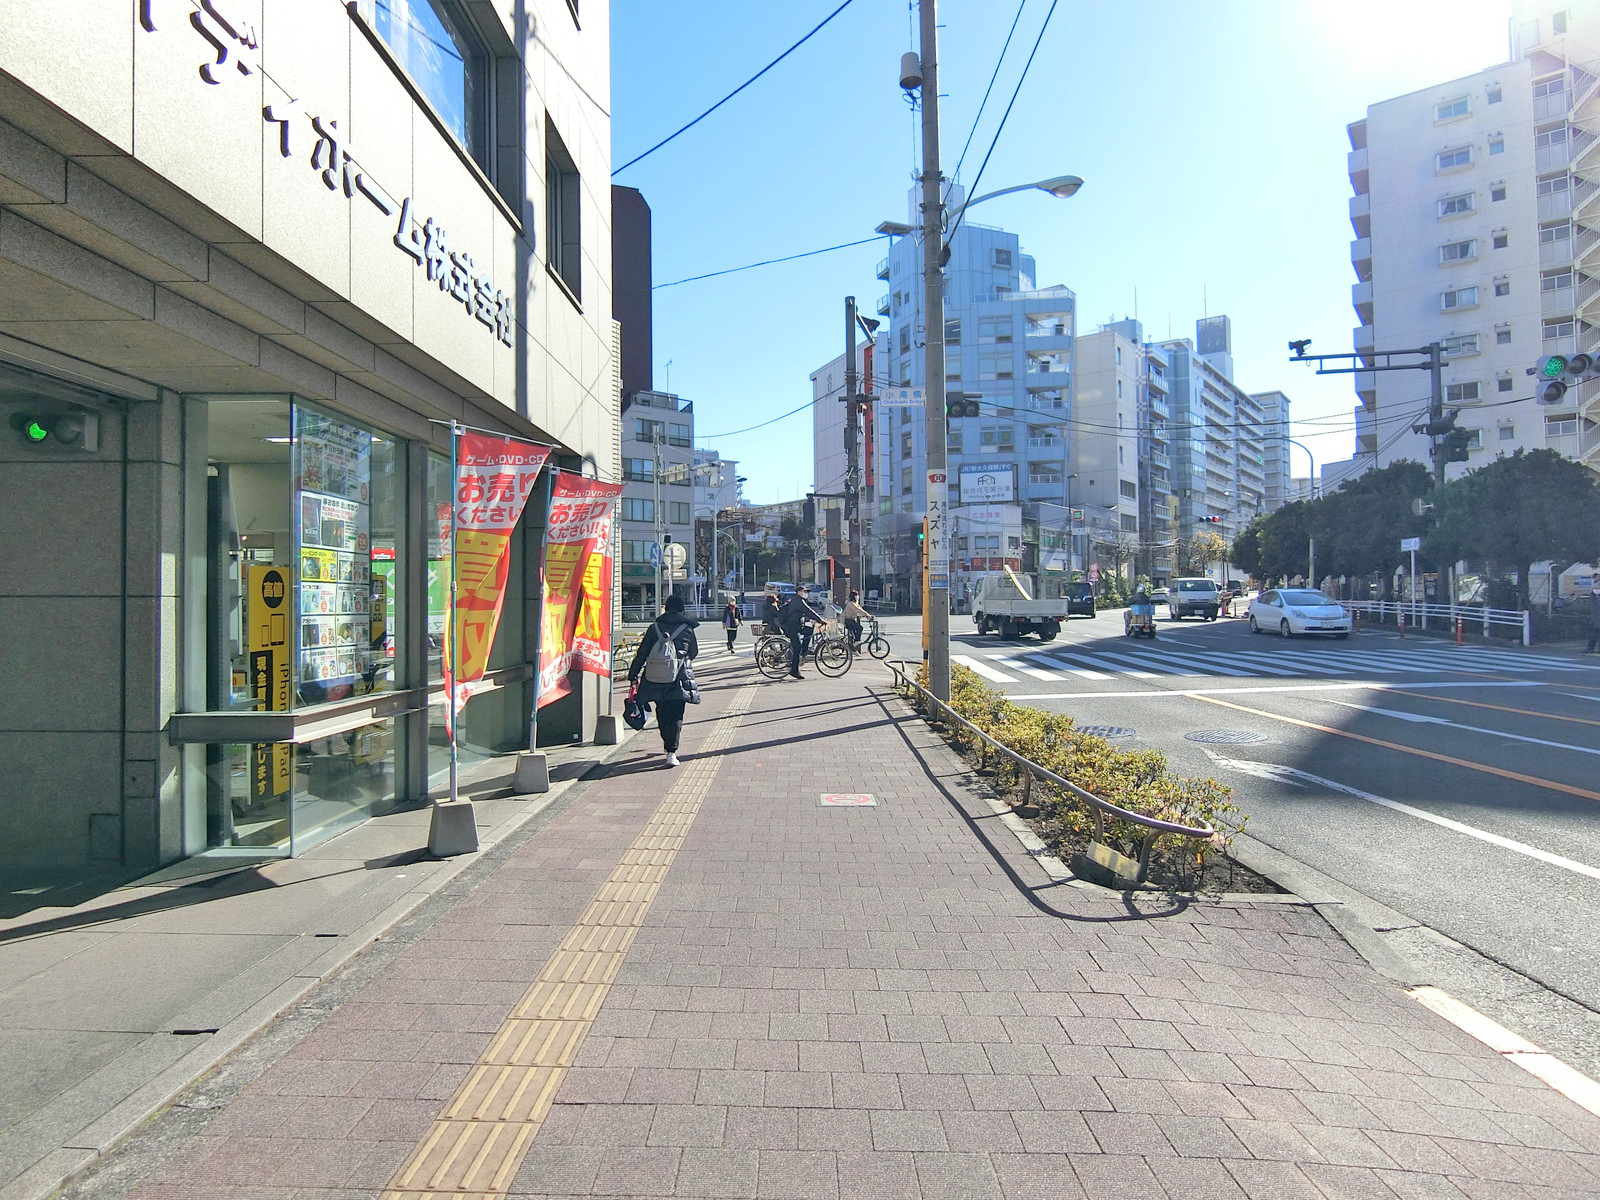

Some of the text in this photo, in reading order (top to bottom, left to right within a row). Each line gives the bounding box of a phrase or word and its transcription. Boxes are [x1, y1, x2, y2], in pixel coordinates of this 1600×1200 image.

[885, 390, 922, 400] 小滝橋
[457, 472, 537, 504] お売り
[549, 501, 609, 525] お売り
[445, 530, 510, 682] 買取
[540, 543, 585, 659] 買取
